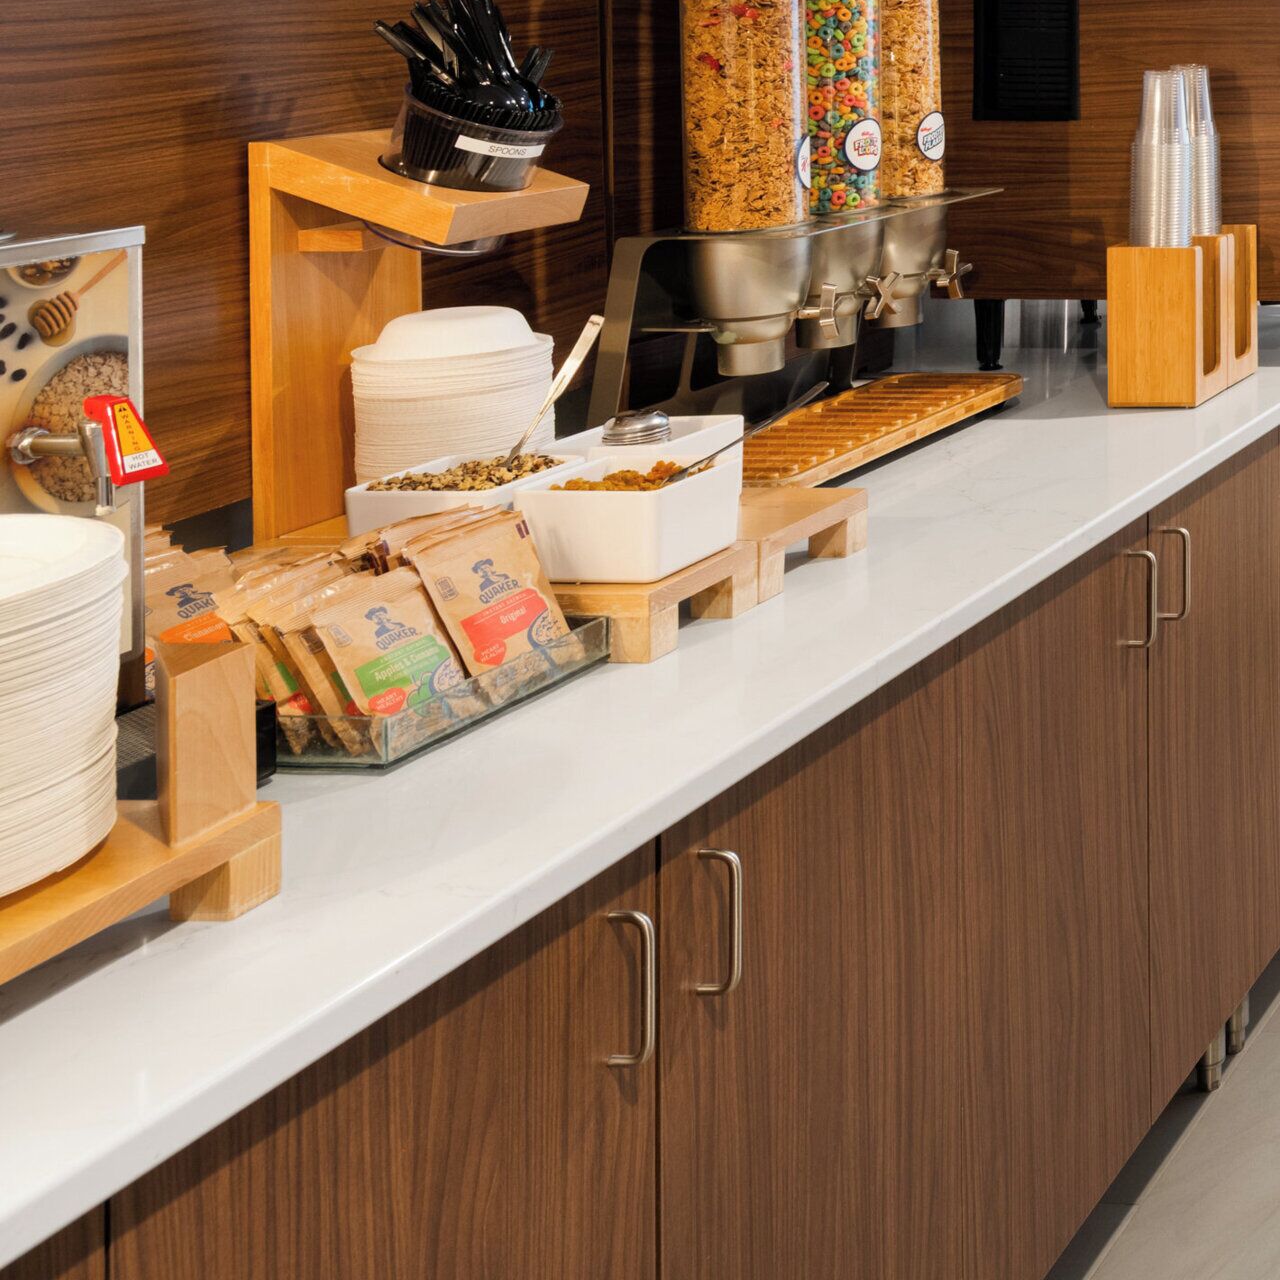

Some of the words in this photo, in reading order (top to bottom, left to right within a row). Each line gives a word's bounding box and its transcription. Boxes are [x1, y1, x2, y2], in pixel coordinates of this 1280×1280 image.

[489, 145, 527, 156] SPOONS
[128, 458, 158, 471] WATER
[132, 452, 149, 461] HOT
[479, 579, 521, 604] QUAKER
[500, 606, 527, 624] Original
[375, 626, 418, 651] QUAKER
[373, 662, 405, 681] Apples
